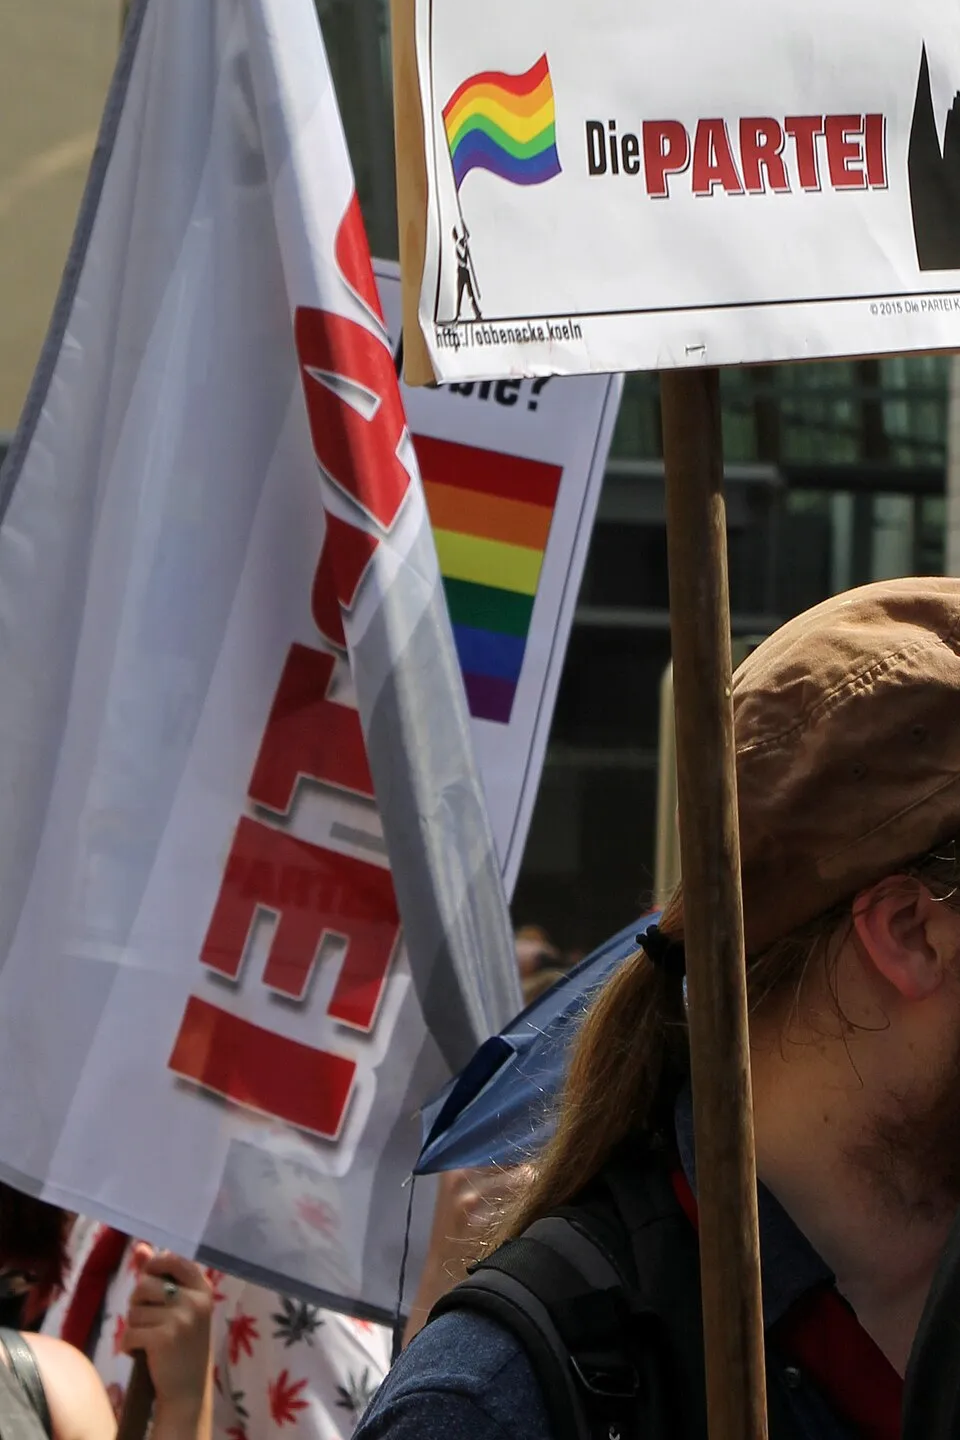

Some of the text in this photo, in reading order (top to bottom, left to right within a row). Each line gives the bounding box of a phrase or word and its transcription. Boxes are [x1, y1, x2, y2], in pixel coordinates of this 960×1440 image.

[585, 113, 889, 199] Die PARTEI
[880, 301, 903, 316] 2015
[904, 299, 919, 314] Die
[920, 297, 953, 313] PARTEI
